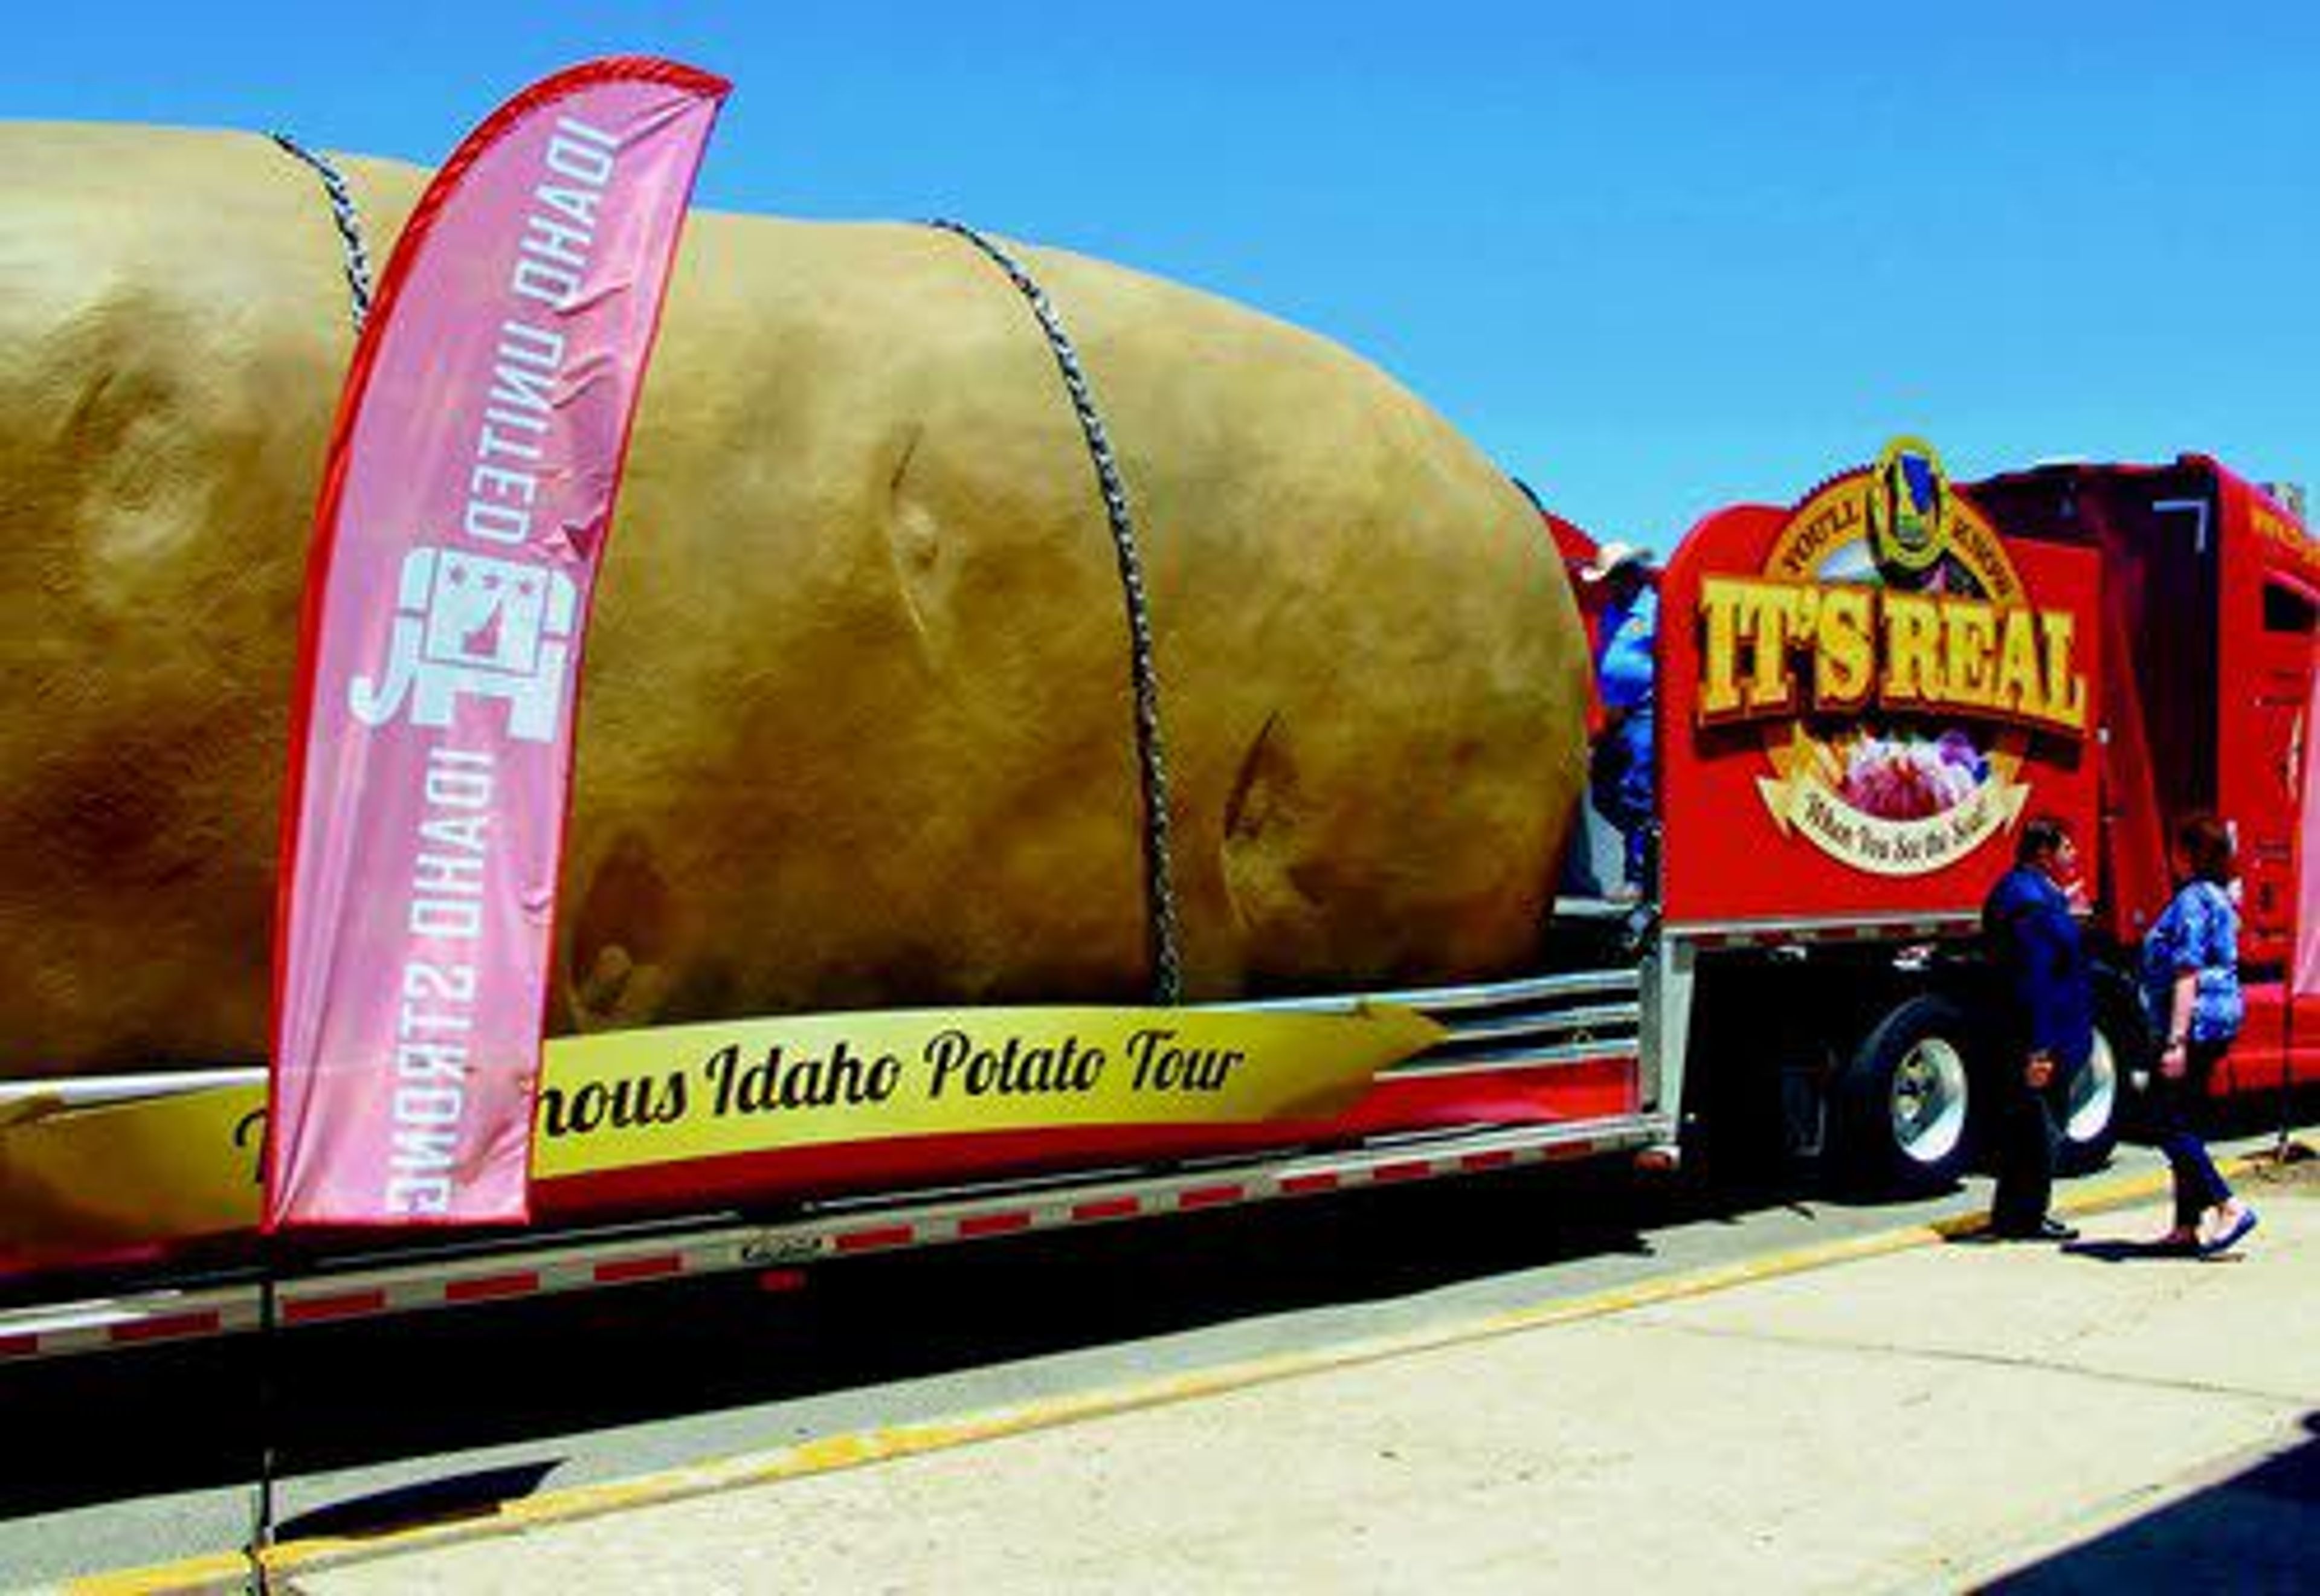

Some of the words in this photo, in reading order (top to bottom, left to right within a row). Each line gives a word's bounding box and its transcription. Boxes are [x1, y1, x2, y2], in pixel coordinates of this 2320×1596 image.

[1698, 576, 1873, 714] IT'S
[1880, 587, 2088, 729] REAL
[704, 1039, 901, 1116] Idaho
[923, 1029, 1106, 1098] Potato
[1126, 1029, 1245, 1091] Tour
